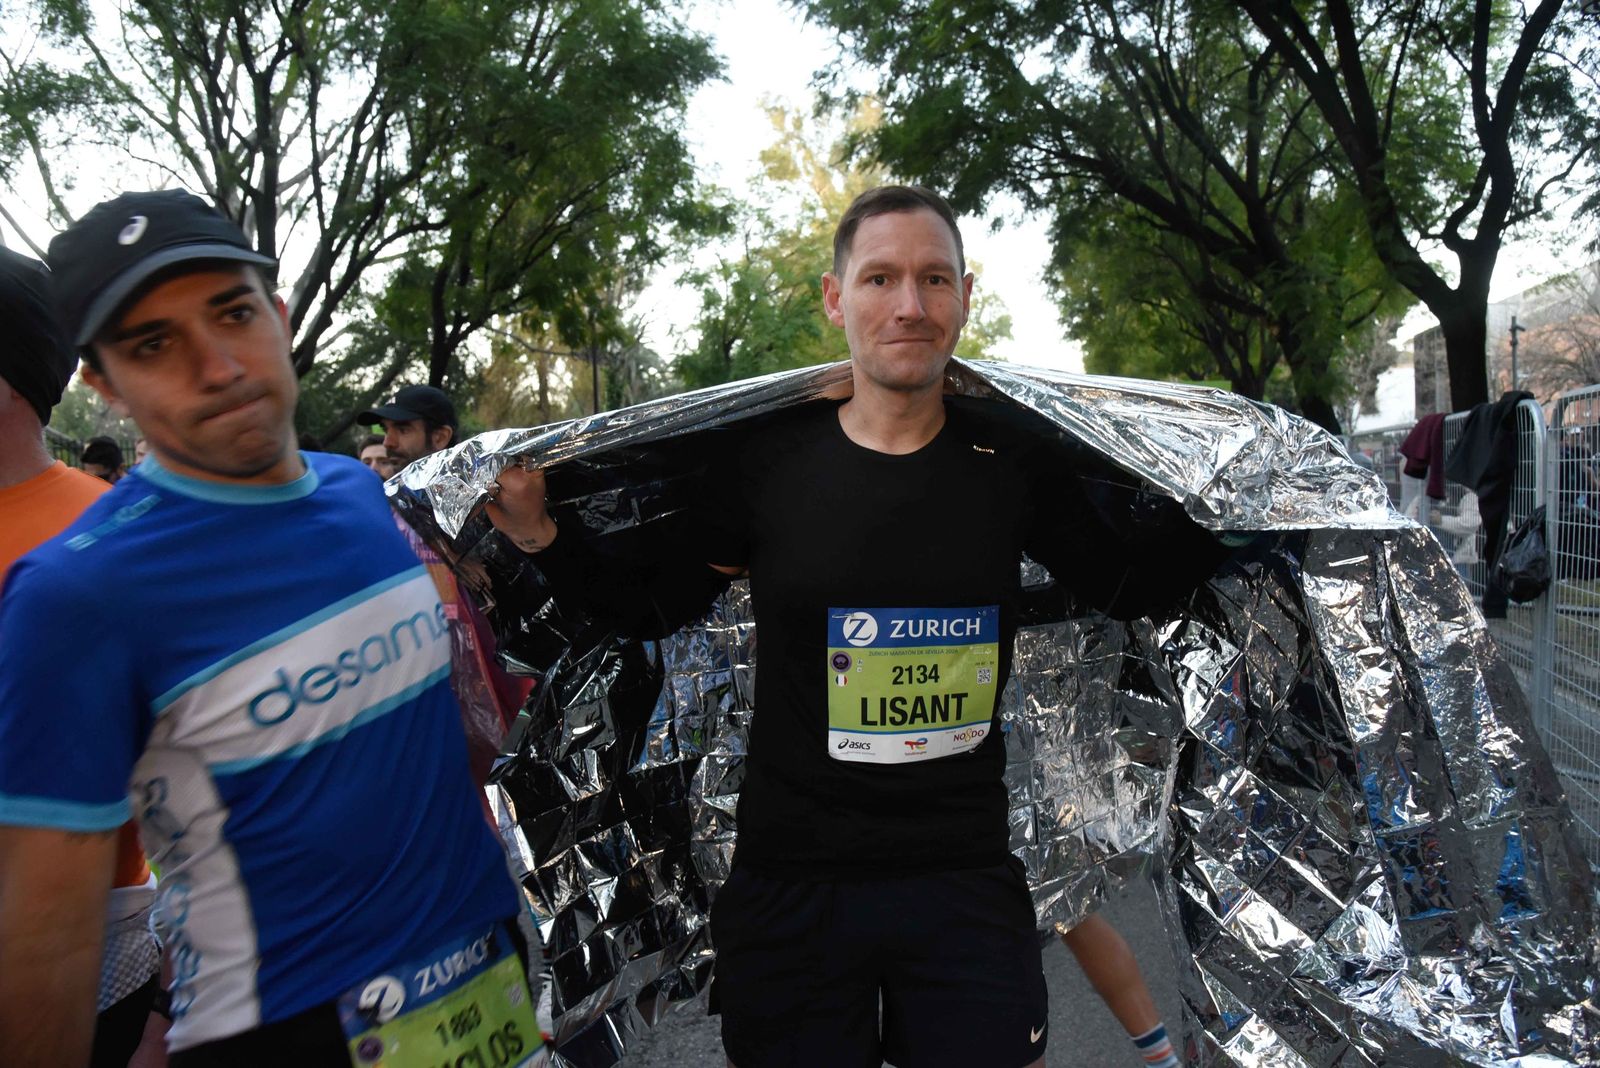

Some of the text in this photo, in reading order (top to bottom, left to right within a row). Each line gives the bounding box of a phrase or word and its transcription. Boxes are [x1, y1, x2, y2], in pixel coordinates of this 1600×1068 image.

[889, 617, 980, 639] ZURICH
[892, 664, 940, 686] 2134
[860, 692, 968, 727] LISANT
[414, 934, 492, 998] ZURIC
